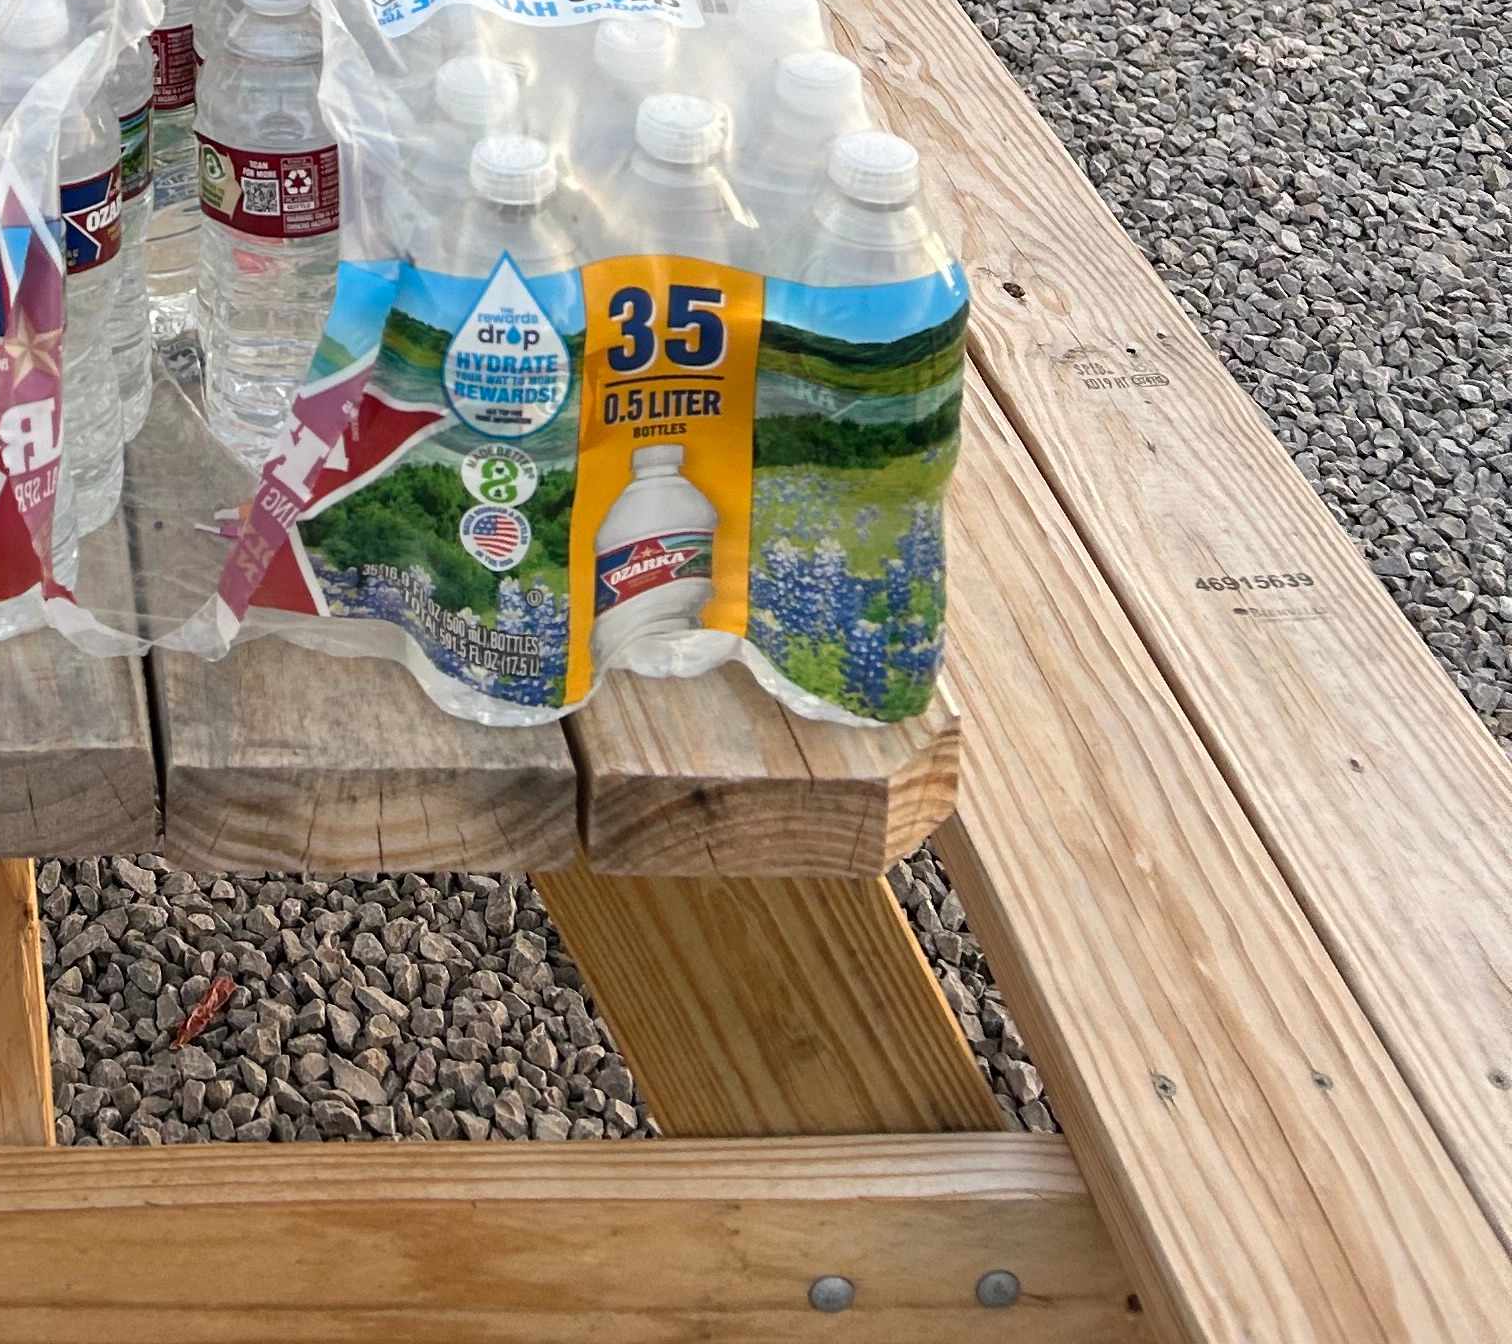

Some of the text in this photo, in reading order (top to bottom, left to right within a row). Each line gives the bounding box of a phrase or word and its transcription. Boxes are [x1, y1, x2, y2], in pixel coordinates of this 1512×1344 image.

[477, 312, 538, 324] rewards
[477, 325, 541, 351] drop
[607, 284, 728, 377] 35
[455, 351, 559, 374] HYDRATE
[455, 370, 482, 381] YOUR
[486, 375, 508, 384] WAY
[511, 375, 525, 385] TO
[453, 381, 558, 405] REWARDS!
[604, 388, 722, 425] 0.5 LITER
[632, 422, 688, 439] BOTTLES
[610, 552, 686, 585] OZARKA
[1194, 571, 1315, 593] 46915639
[439, 627, 467, 658] 591.5
[469, 644, 482, 665] FL
[483, 650, 499, 671] OZ
[501, 654, 527, 676] (17.5
[490, 631, 540, 656] BOTTLES
